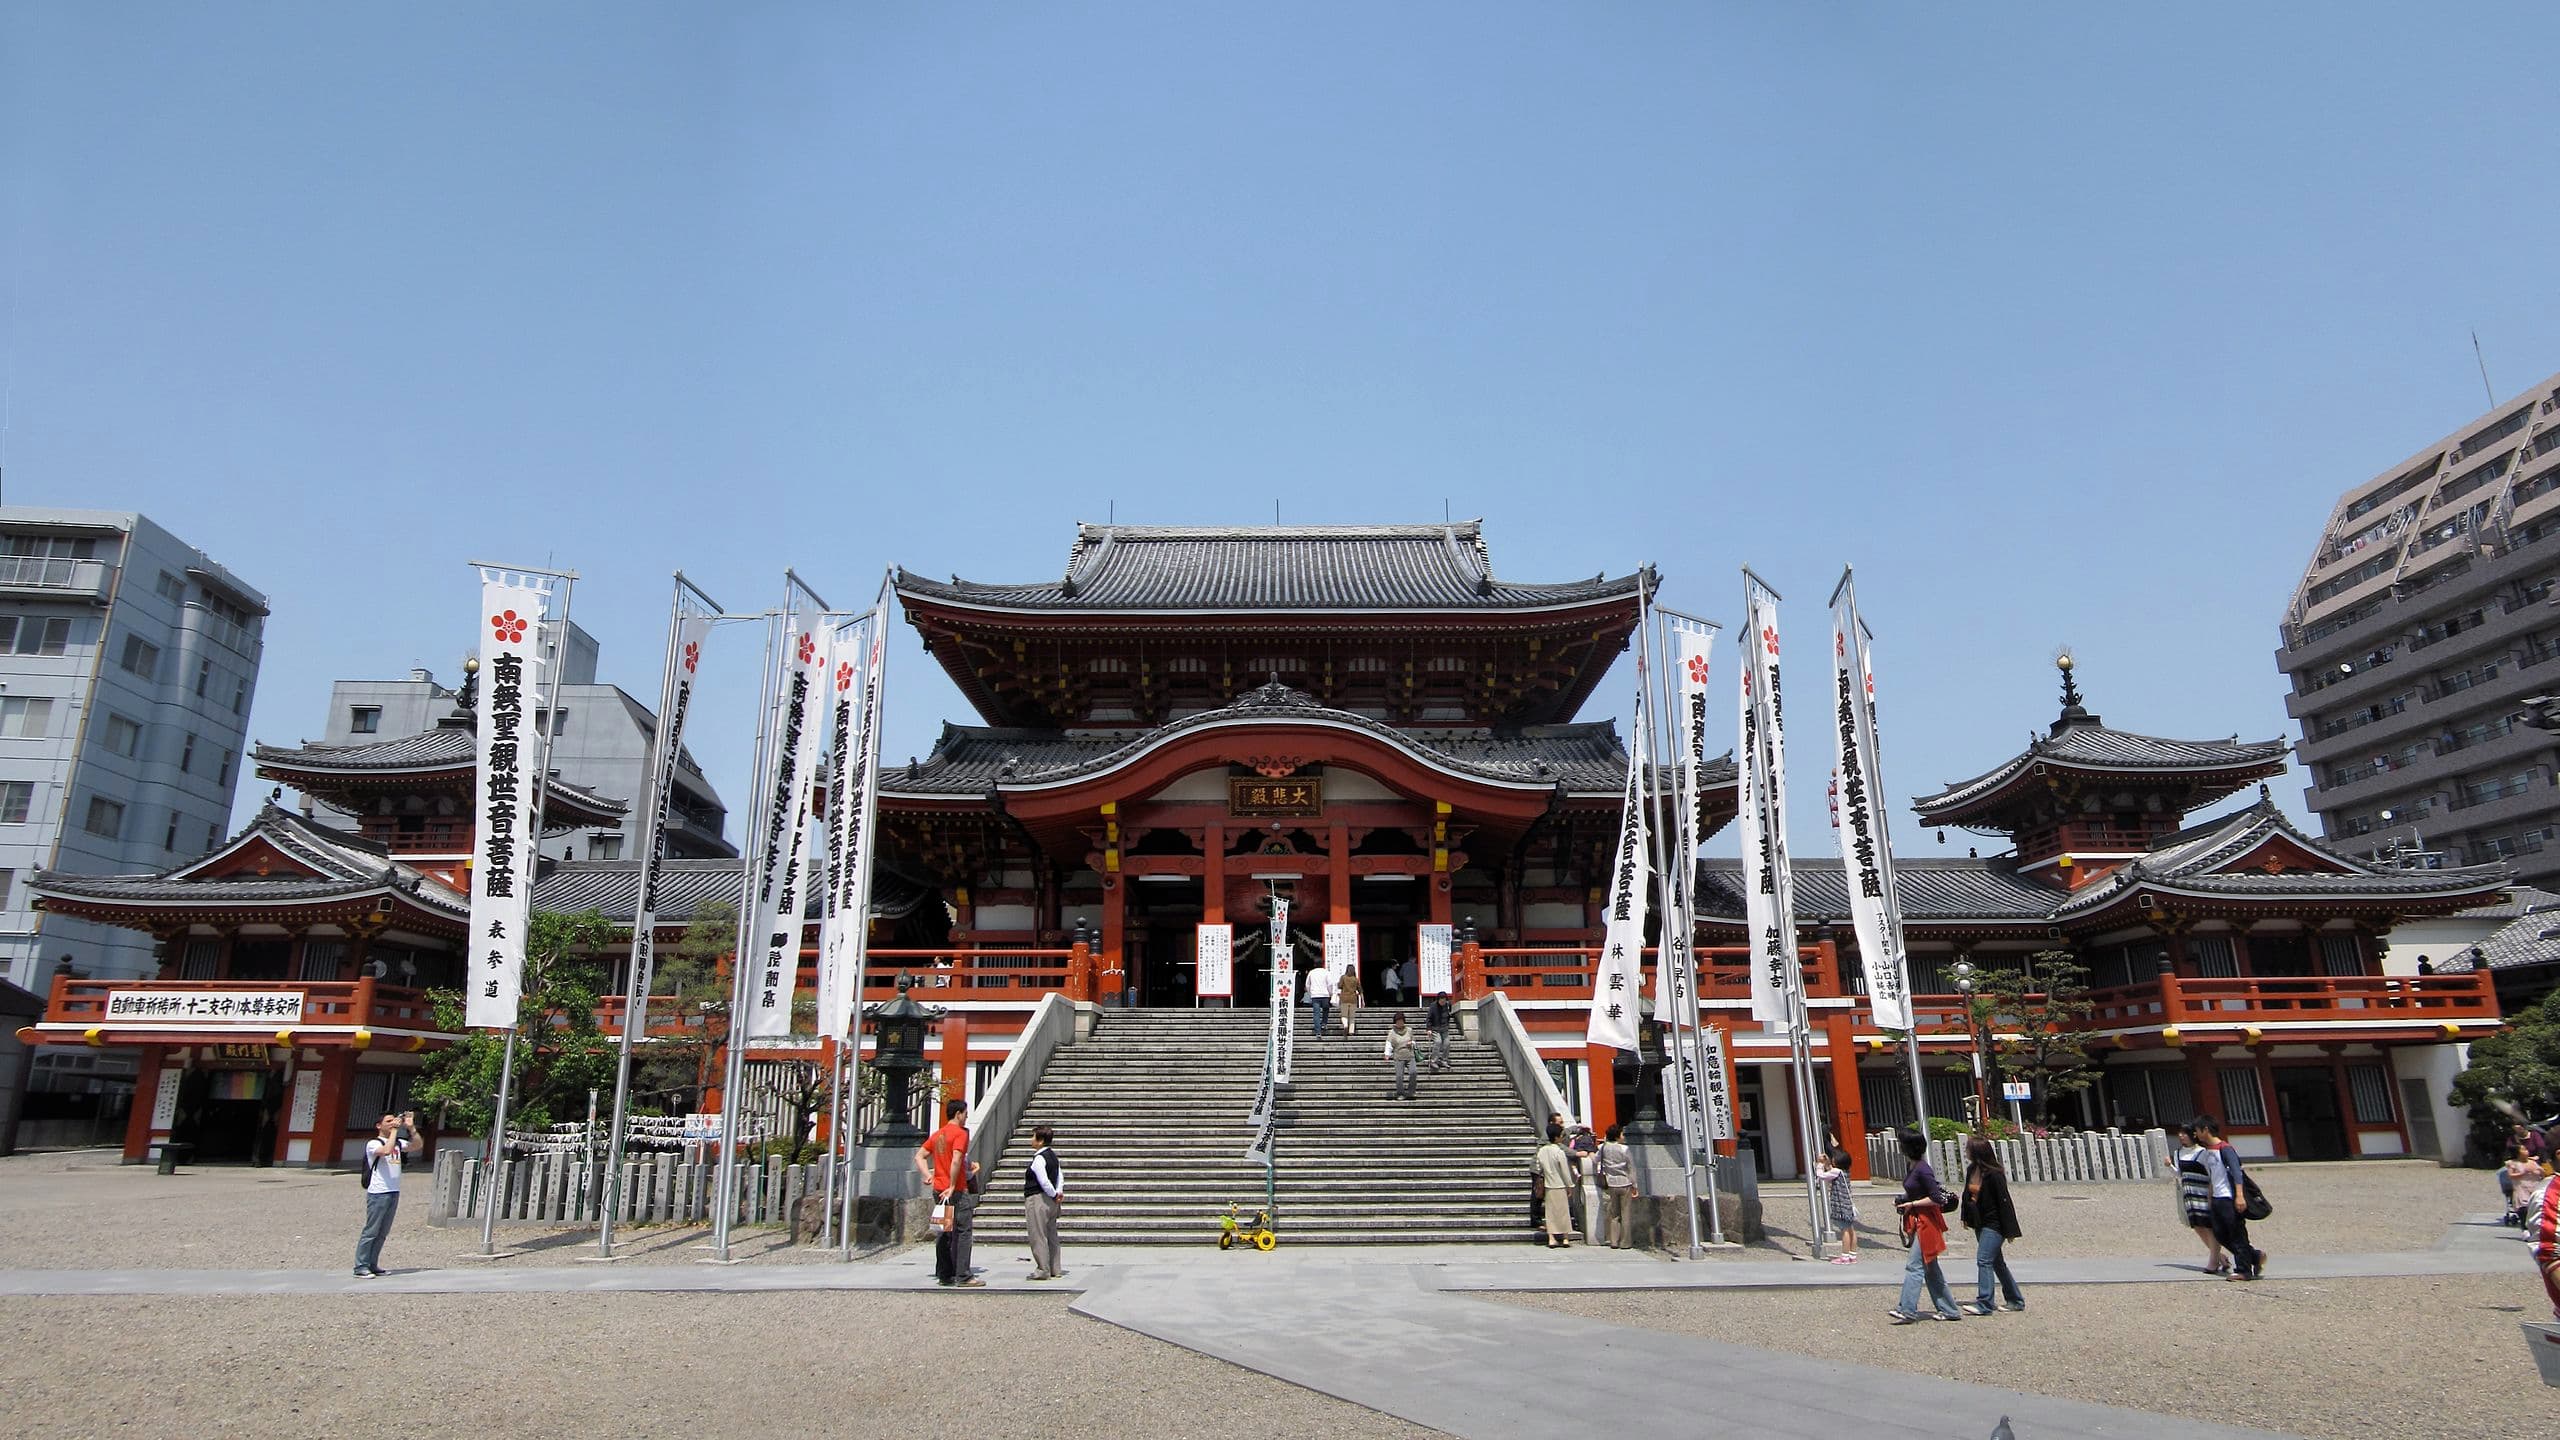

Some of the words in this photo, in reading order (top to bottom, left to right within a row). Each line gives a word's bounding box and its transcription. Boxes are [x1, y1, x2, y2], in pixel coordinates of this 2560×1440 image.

[484, 919, 506, 999] 表参道
[1607, 942, 1624, 1021] 林雲華
